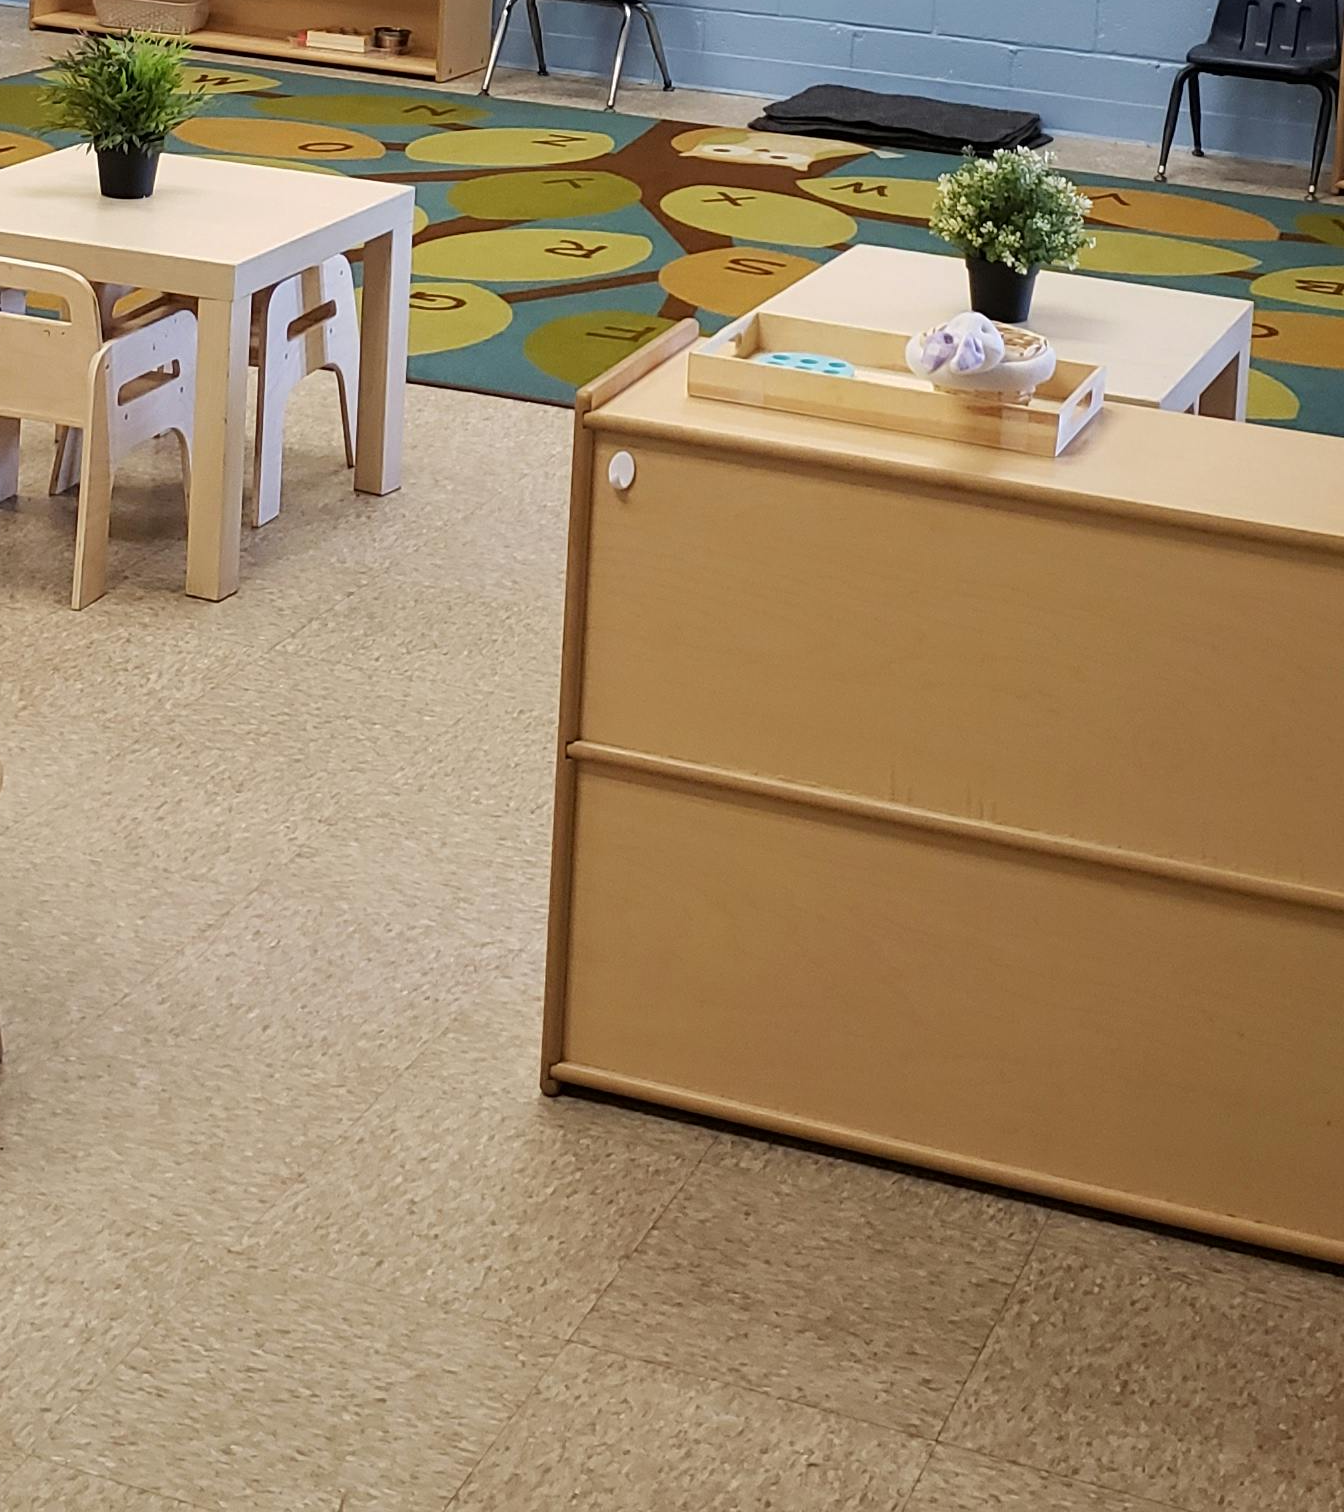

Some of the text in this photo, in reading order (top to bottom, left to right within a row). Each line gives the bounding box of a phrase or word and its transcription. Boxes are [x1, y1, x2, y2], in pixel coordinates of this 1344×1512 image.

[701, 191, 757, 207] X
[543, 239, 609, 259] R
[724, 257, 787, 276] S
[585, 326, 657, 343] F
